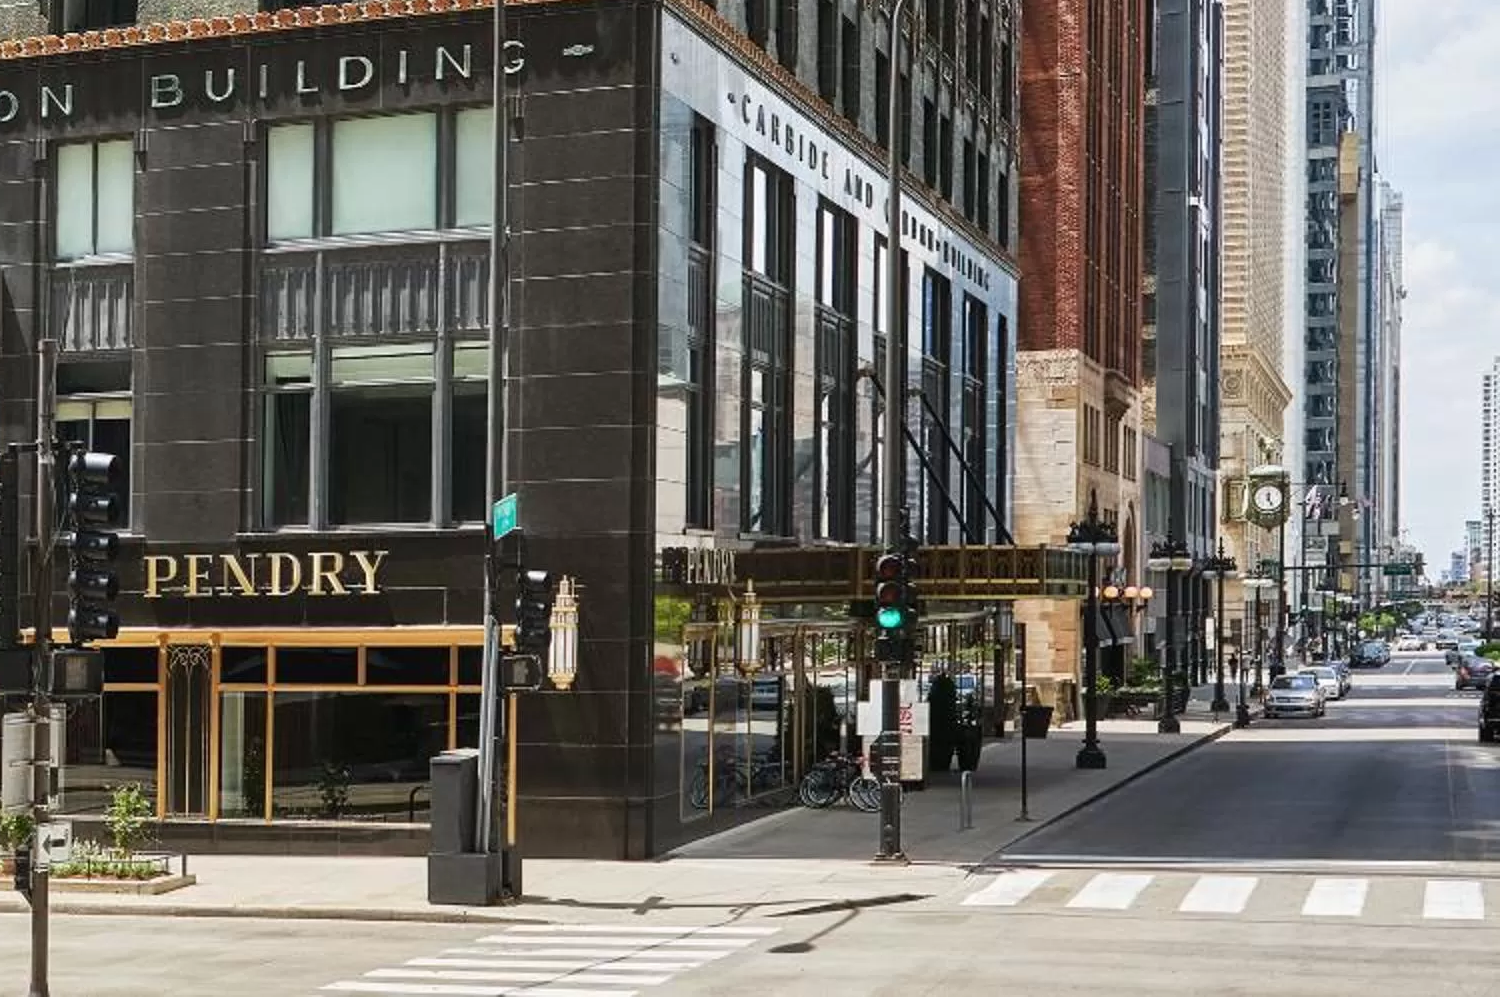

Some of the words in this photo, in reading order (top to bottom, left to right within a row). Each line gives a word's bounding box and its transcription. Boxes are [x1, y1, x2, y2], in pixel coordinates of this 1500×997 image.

[150, 40, 525, 108] BUILDING
[741, 94, 829, 180] CARBIDE
[844, 168, 873, 209] AND
[143, 550, 389, 598] PENDRY
